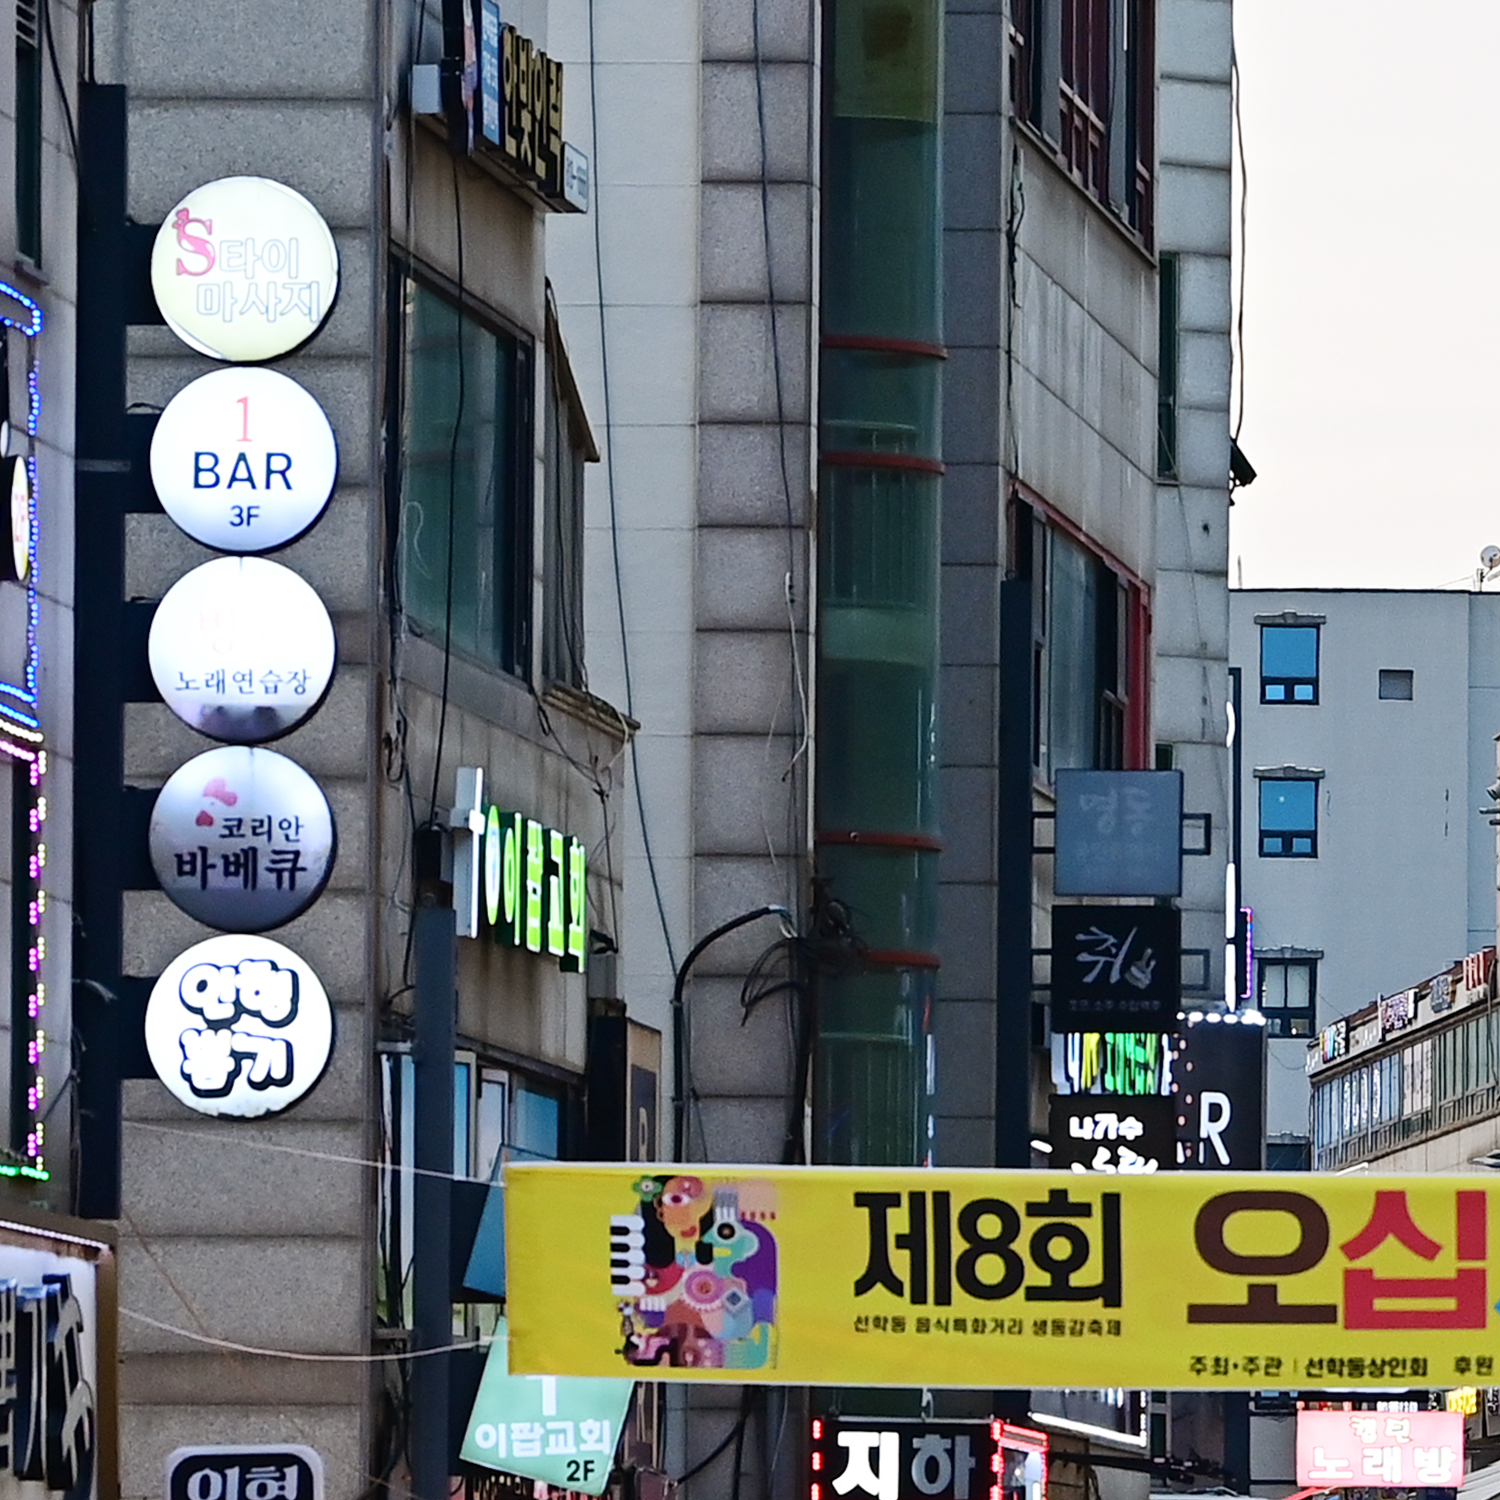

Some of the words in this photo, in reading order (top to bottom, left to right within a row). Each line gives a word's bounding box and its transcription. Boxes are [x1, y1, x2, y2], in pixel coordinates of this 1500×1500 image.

[172, 208, 299, 280] S타이
[197, 281, 320, 323] 마사지
[193, 451, 293, 491] BAR
[229, 505, 260, 527] 3F
[175, 668, 311, 695] 노래연습장
[218, 814, 304, 842] 코리안
[174, 848, 307, 893] 바베큐
[179, 959, 300, 1029] 인형
[179, 1026, 295, 1099] 뽑기
[853, 1189, 1123, 1309] 제8회
[853, 1315, 907, 1334] 선학동
[915, 1316, 1024, 1337] 음식특화거리
[1031, 1318, 1122, 1338] 생동감축제
[1304, 1356, 1428, 1378] 선학동상인회
[1453, 1356, 1494, 1377] 후원
[566, 1459, 595, 1482] 2F
[1308, 1446, 1458, 1484] 노래방
